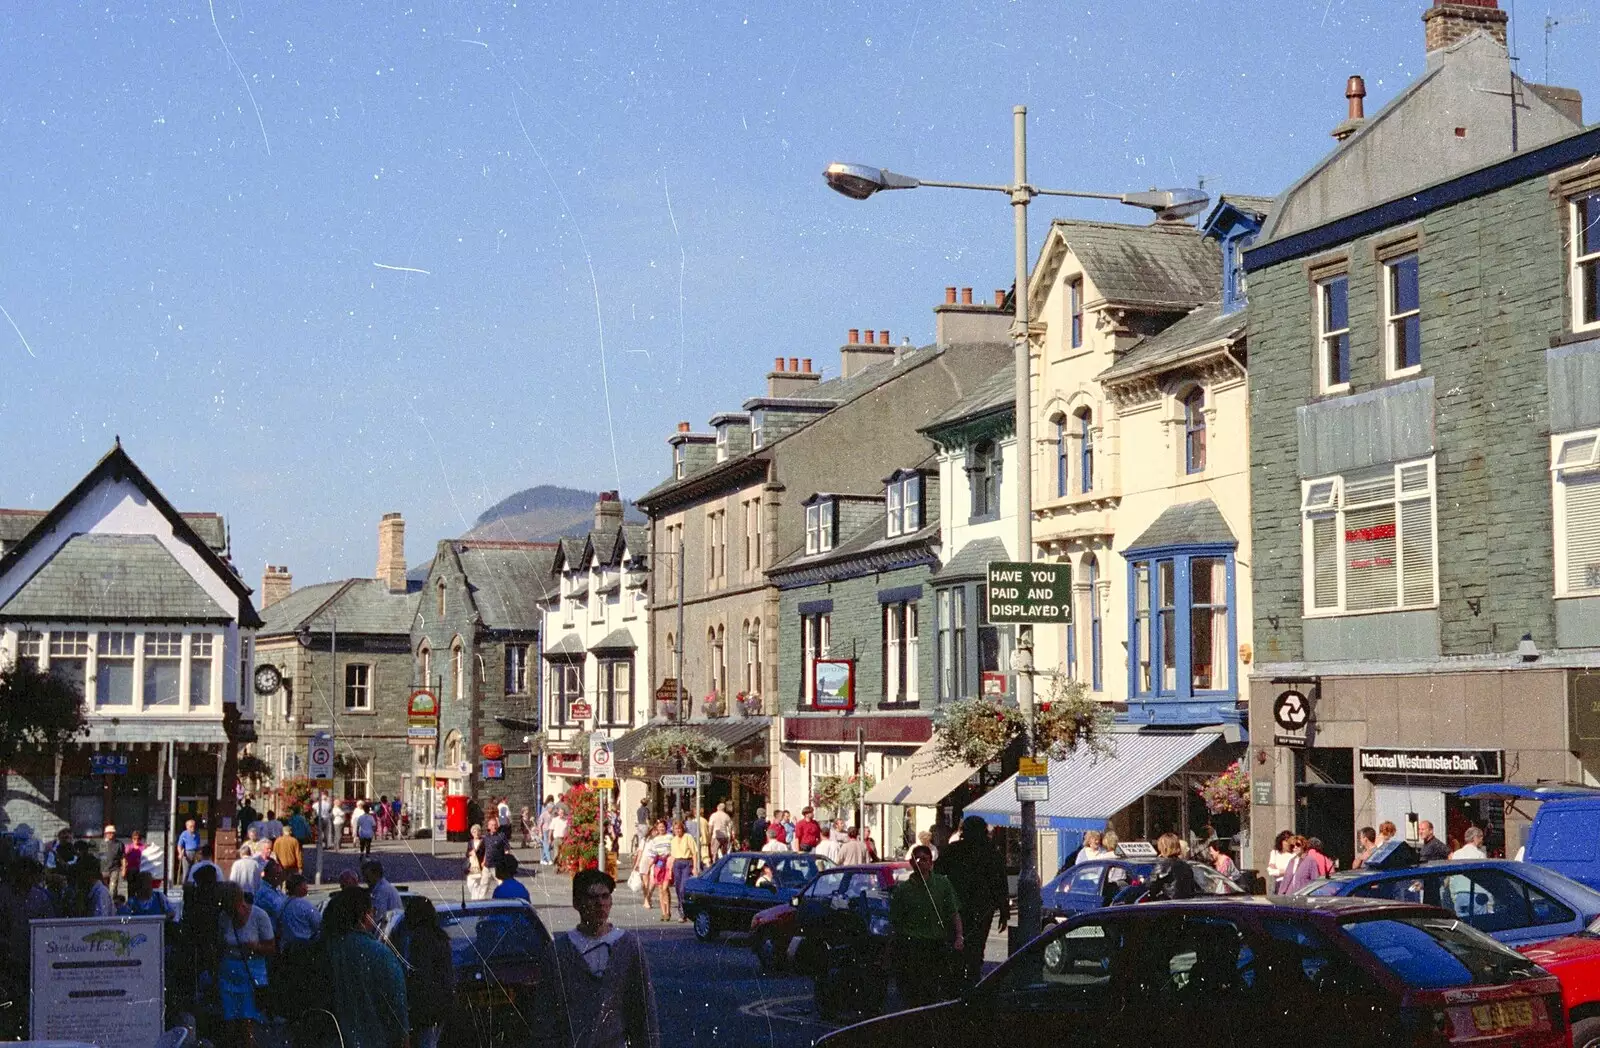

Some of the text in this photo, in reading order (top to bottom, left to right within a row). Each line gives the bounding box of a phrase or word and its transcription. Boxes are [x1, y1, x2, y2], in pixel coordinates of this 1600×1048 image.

[991, 571, 1056, 583] HAVE YOU
[991, 587, 1053, 600] PAID AND
[93, 755, 128, 765] TSB
[1361, 753, 1478, 771] National Westminster Bank
